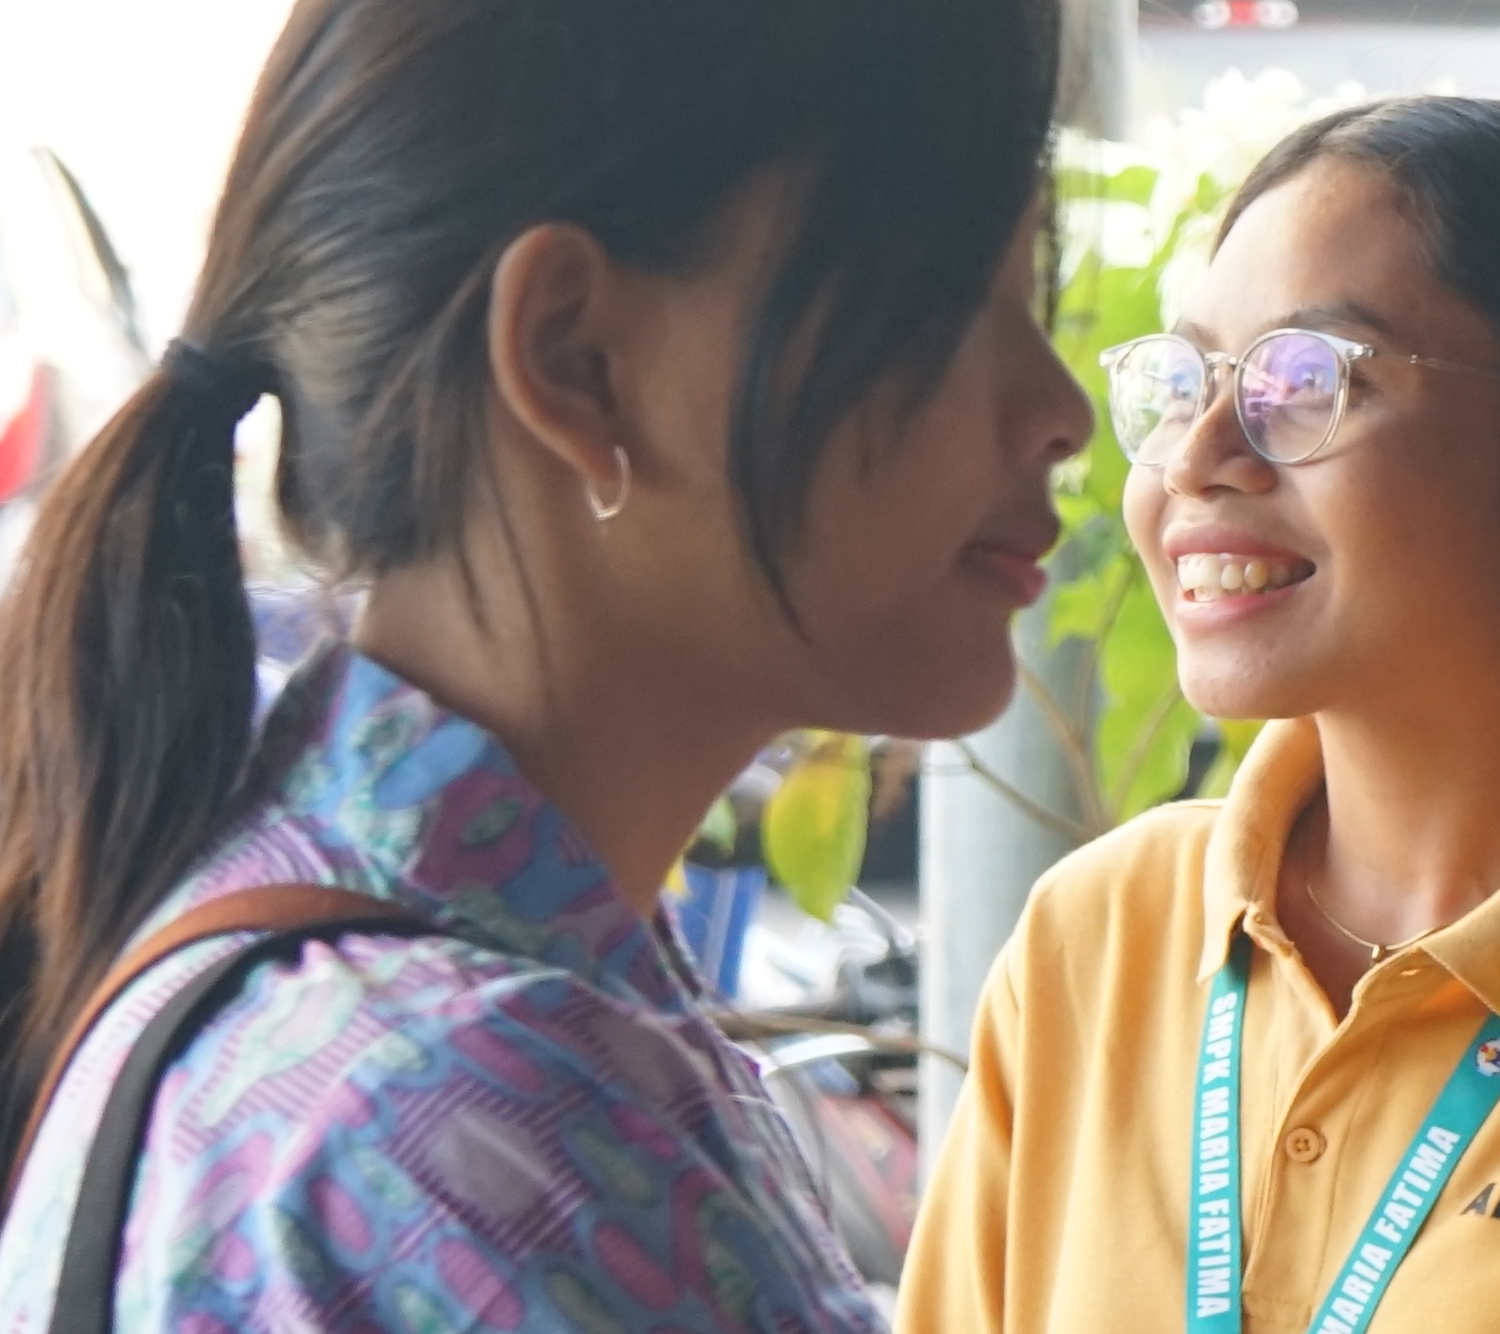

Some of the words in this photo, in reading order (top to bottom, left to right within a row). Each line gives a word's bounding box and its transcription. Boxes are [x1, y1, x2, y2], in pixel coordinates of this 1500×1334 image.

[1203, 992, 1237, 1084] SMPK
[1199, 1086, 1230, 1195] MARIA
[1373, 1126, 1460, 1244] FATIMA
[1197, 1199, 1231, 1318] FATIMA
